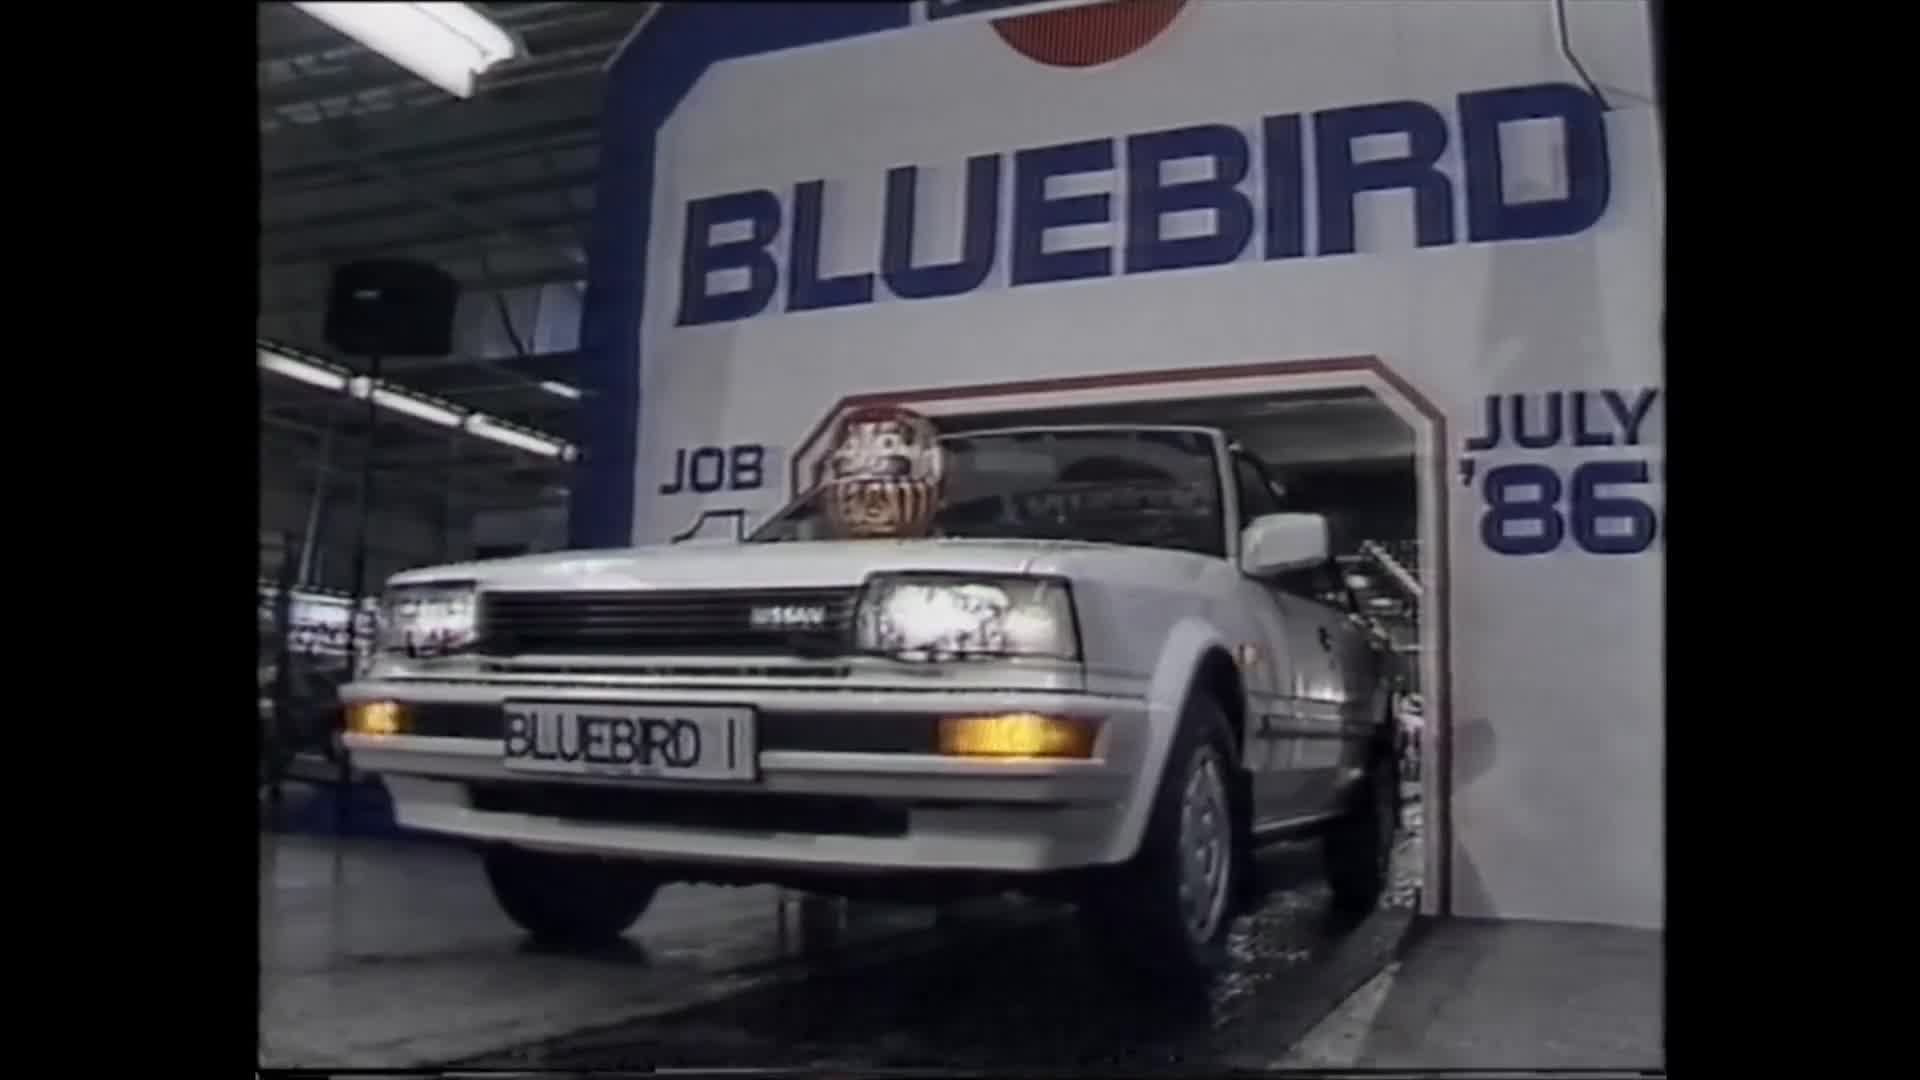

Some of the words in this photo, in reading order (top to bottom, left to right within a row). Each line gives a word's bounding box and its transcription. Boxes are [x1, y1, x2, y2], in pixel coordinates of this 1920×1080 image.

[675, 83, 1611, 327] BLUEBIRD
[1464, 388, 1658, 450] JULY
[660, 445, 764, 494] JOB
[504, 711, 700, 768] BLUEBIRD
